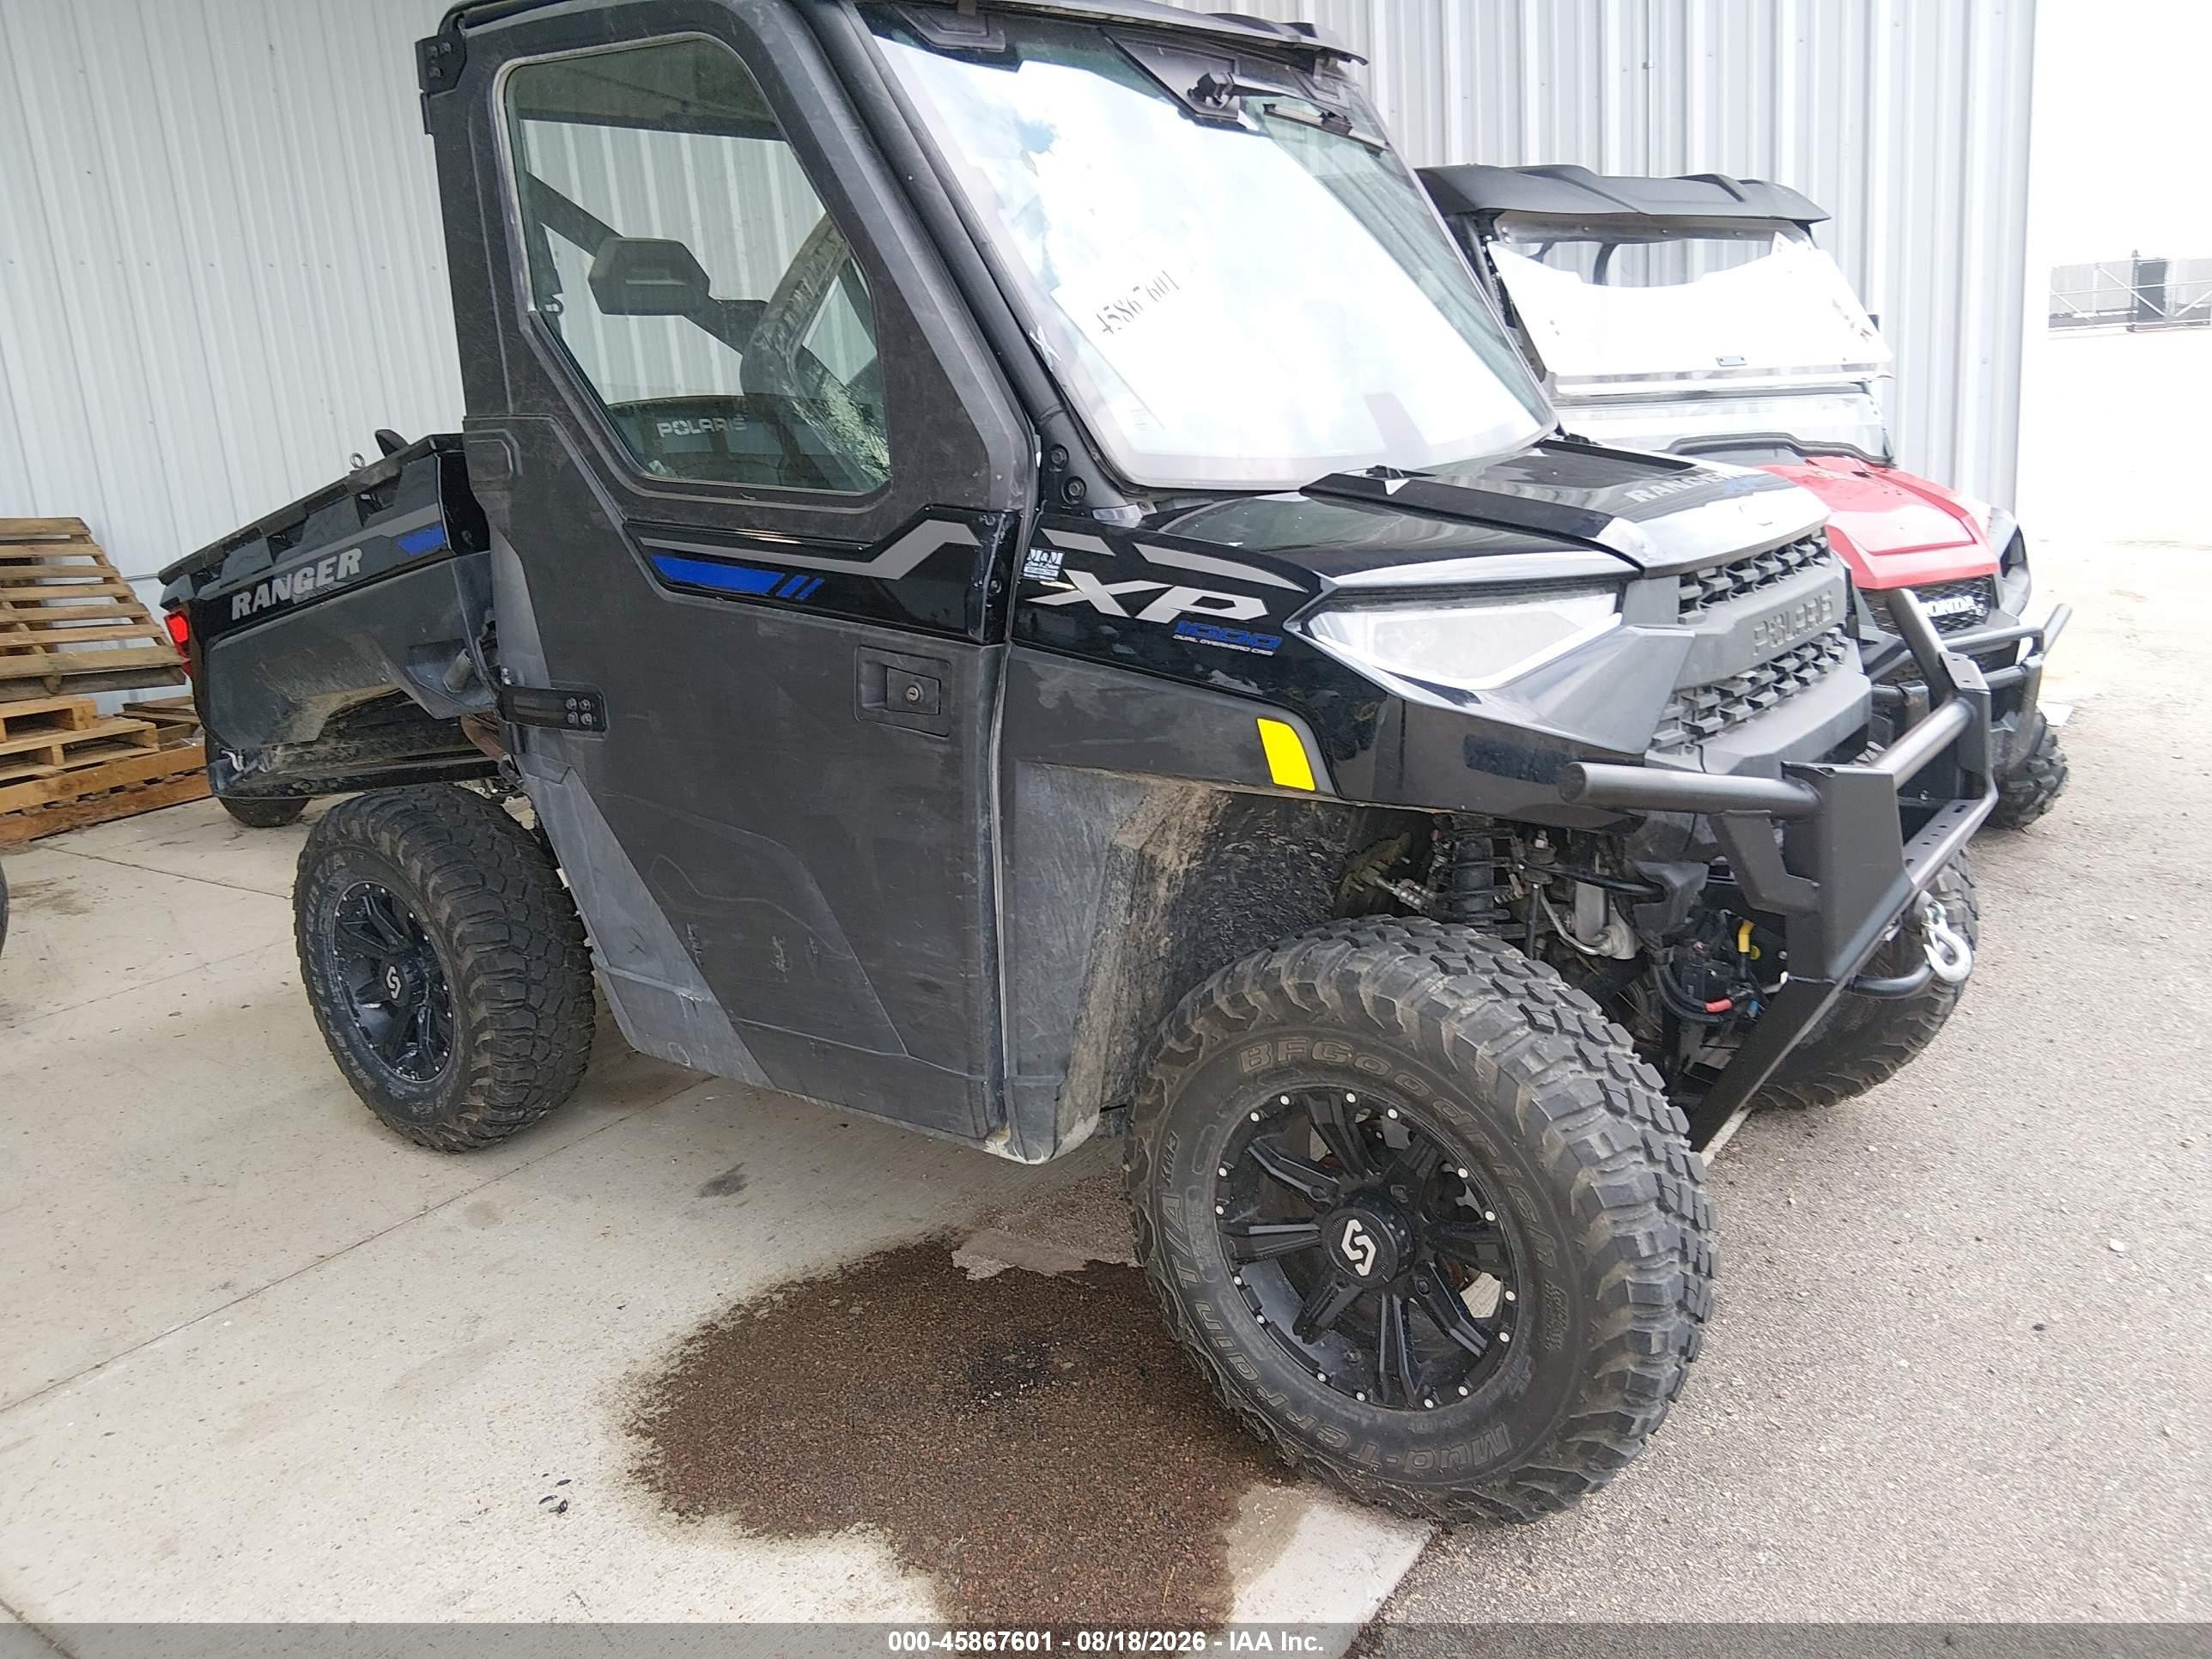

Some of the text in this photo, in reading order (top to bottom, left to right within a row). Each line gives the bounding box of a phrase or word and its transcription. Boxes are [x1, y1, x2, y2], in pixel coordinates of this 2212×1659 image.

[656, 414, 747, 438] POLARIS
[231, 547, 363, 621] RANGER
[1024, 568, 1269, 624] XP
[1175, 620, 1283, 651] 1000
[1752, 590, 1833, 657] POLARIS
[1238, 1036, 1557, 1269] BFGoodrich
[1161, 1194, 1200, 1289] T/A
